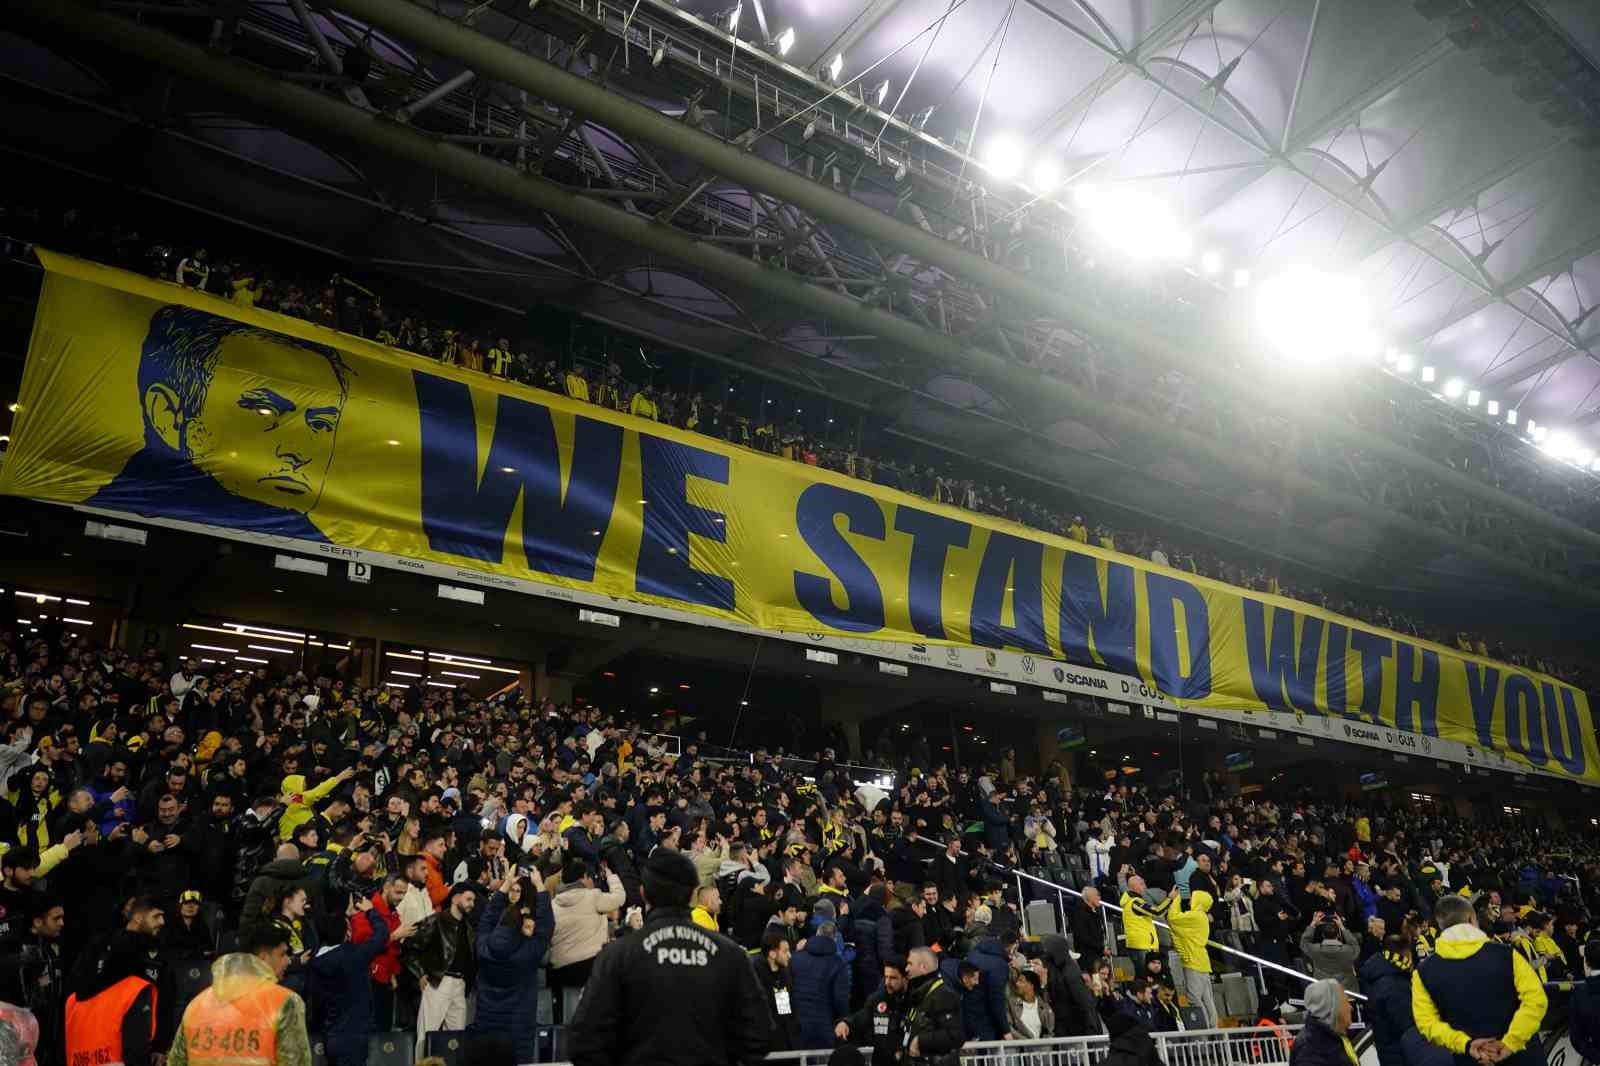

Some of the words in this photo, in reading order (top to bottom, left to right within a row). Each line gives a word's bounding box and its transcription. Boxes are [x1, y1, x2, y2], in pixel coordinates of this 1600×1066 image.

[319, 544, 362, 559] SEAT
[355, 560, 367, 576] D
[412, 369, 736, 612] WE
[794, 482, 1212, 699] STAND
[1242, 597, 1441, 738] WITH
[1463, 660, 1585, 775] YOU
[1066, 672, 1109, 690] SCANIA
[1351, 728, 1380, 741] SCANIA
